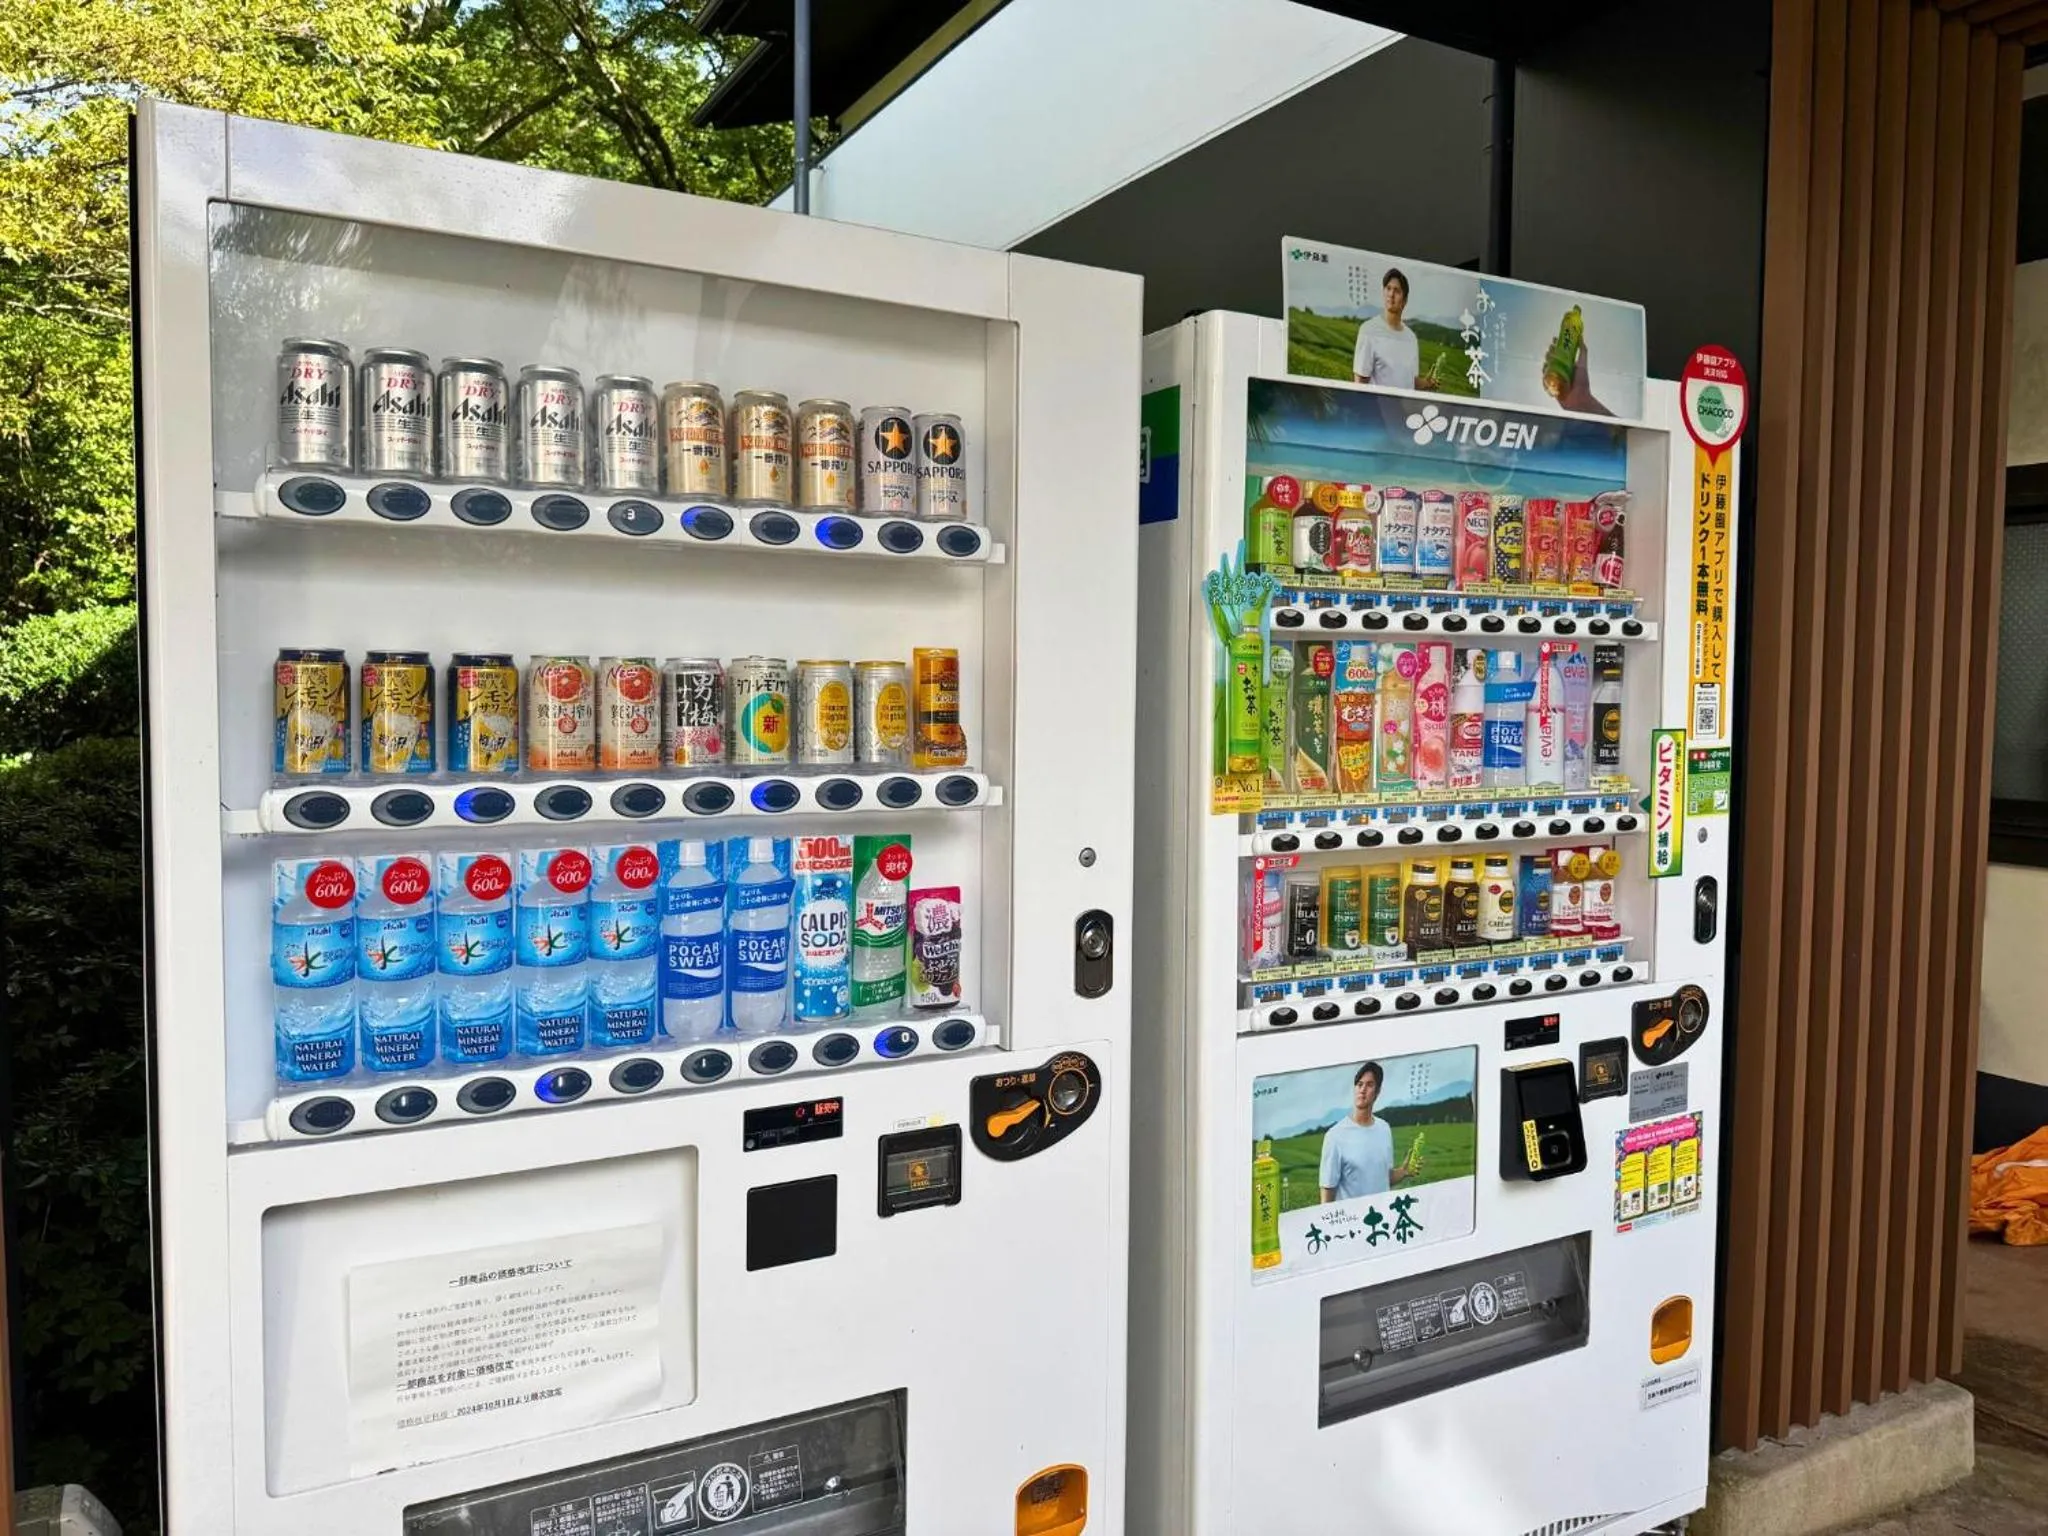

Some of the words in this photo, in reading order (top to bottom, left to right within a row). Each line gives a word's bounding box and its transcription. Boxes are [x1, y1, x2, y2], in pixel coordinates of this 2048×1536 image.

[1459, 307, 1492, 390] お茶
[280, 380, 342, 409] Asahi
[372, 389, 432, 418] Asahi
[451, 397, 508, 423] Asahi
[530, 405, 585, 428] Asahi
[606, 412, 658, 436] Asahi
[1446, 414, 1498, 448] ITO
[1500, 420, 1538, 452] EN
[1696, 472, 1711, 616] ドリンク1本無料
[284, 687, 340, 701] レモン
[370, 689, 421, 702] レモン
[467, 690, 517, 703] レモン
[690, 673, 717, 727] 男梅
[773, 715, 789, 734] 新
[1453, 750, 1481, 758] TANS
[669, 941, 719, 955] POCAR
[738, 935, 786, 951] POCAR
[669, 952, 719, 969] SWEAT
[738, 946, 785, 962] SWEAT
[606, 1008, 648, 1020] NATURAL
[539, 1016, 580, 1028] NATURAL
[607, 1018, 647, 1029] MINERAL
[456, 1024, 502, 1037] NATURAL
[540, 1026, 579, 1038] MINERAL
[611, 1028, 643, 1039] WATER
[374, 1032, 421, 1046] NATURAL
[458, 1034, 500, 1047] MINERAL
[544, 1036, 576, 1048] WATER
[294, 1039, 342, 1054] NATURAL
[376, 1043, 419, 1056] MINERAL
[463, 1044, 497, 1056] WATER
[296, 1050, 343, 1064] MINERAL
[381, 1053, 416, 1065] WATER
[301, 1061, 339, 1074] WATER
